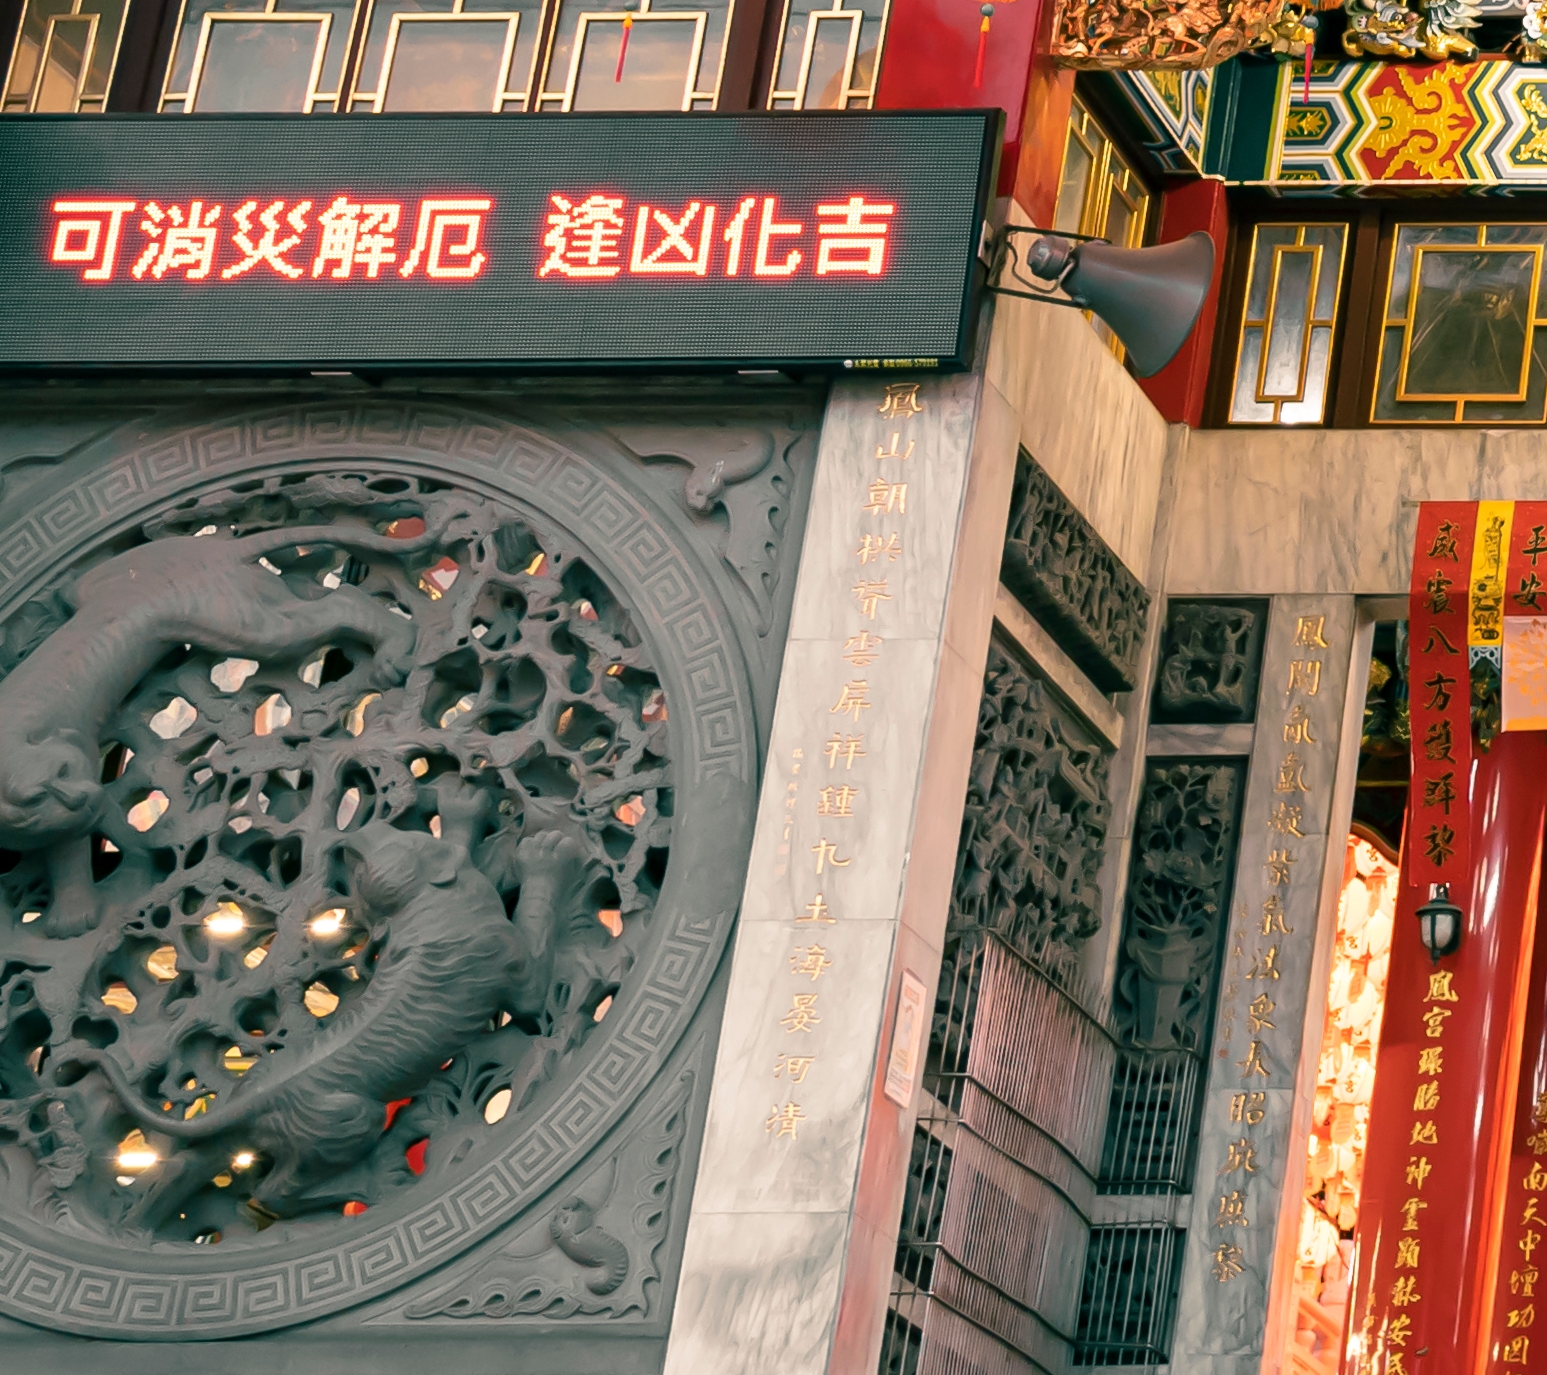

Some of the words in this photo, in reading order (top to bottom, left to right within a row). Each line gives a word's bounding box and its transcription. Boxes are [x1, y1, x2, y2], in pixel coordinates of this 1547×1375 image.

[51, 196, 493, 281] 可消災解厄
[538, 194, 896, 280] 逢凶化吉
